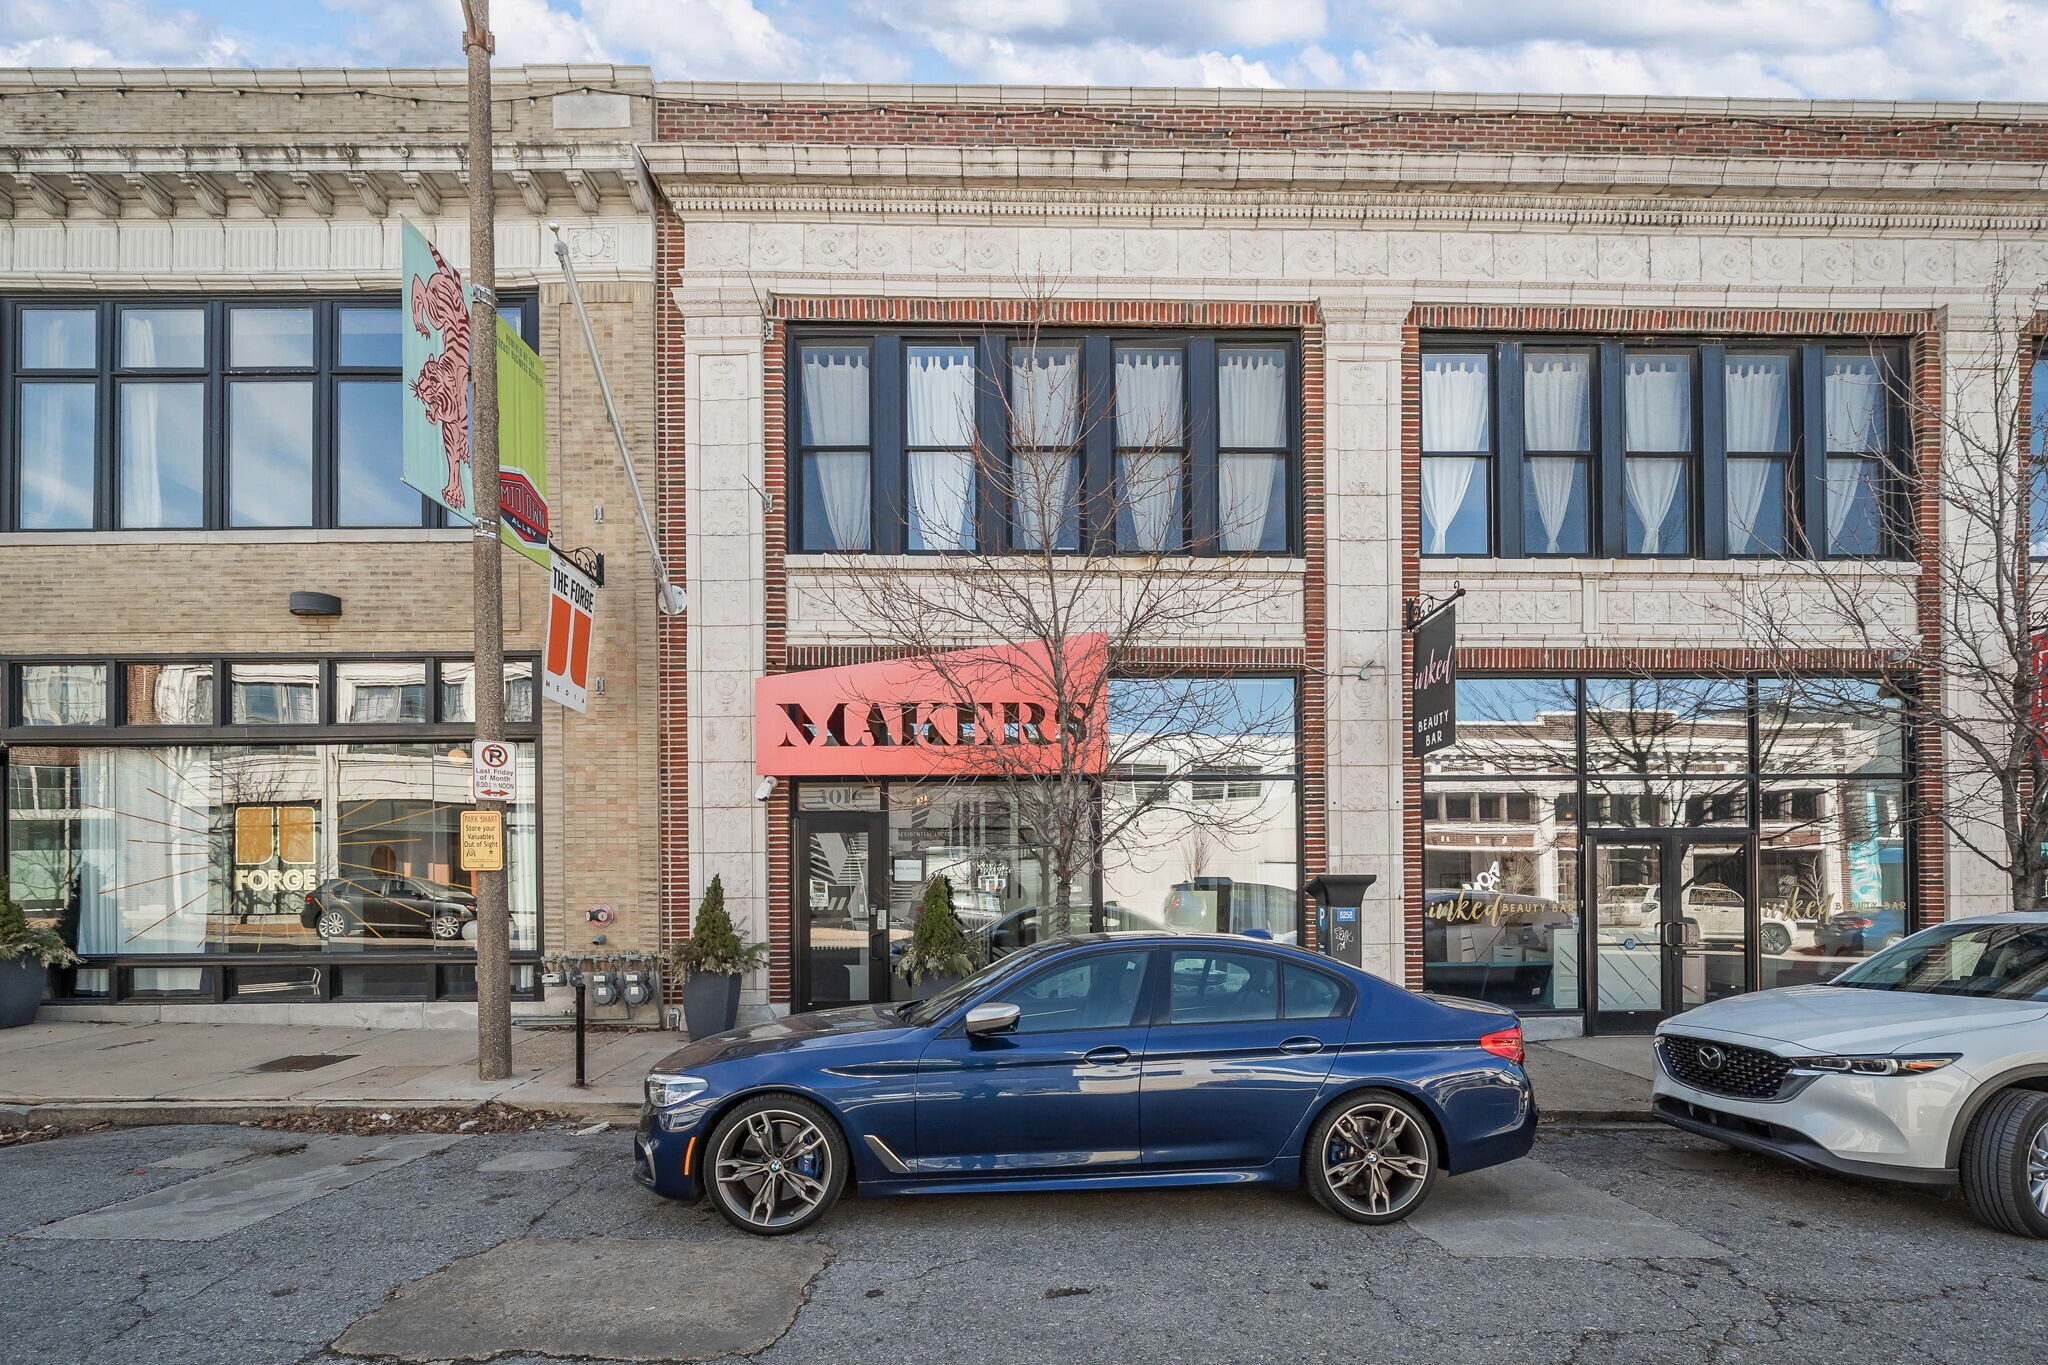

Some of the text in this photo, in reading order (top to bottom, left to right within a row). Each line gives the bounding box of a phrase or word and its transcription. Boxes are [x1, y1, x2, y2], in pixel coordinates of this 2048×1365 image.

[500, 484, 545, 529] MIDTOWN
[511, 517, 537, 537] ALLEY
[552, 566, 594, 614] THE FORGE
[1414, 644, 1454, 691] inked
[545, 679, 585, 704] MEDIA
[776, 702, 1088, 748] MAKERS
[1418, 709, 1450, 733] BEAUTY
[1425, 730, 1443, 747] BAR
[493, 769, 514, 777] Friday
[465, 815, 498, 823] PARK SMART
[465, 824, 481, 832] Store
[464, 840, 499, 850] Out of Sight
[235, 868, 317, 892] FORGE
[1426, 888, 1577, 928] inked BEAUTY BAR
[1762, 886, 1907, 926] inked BAUTY BAR
